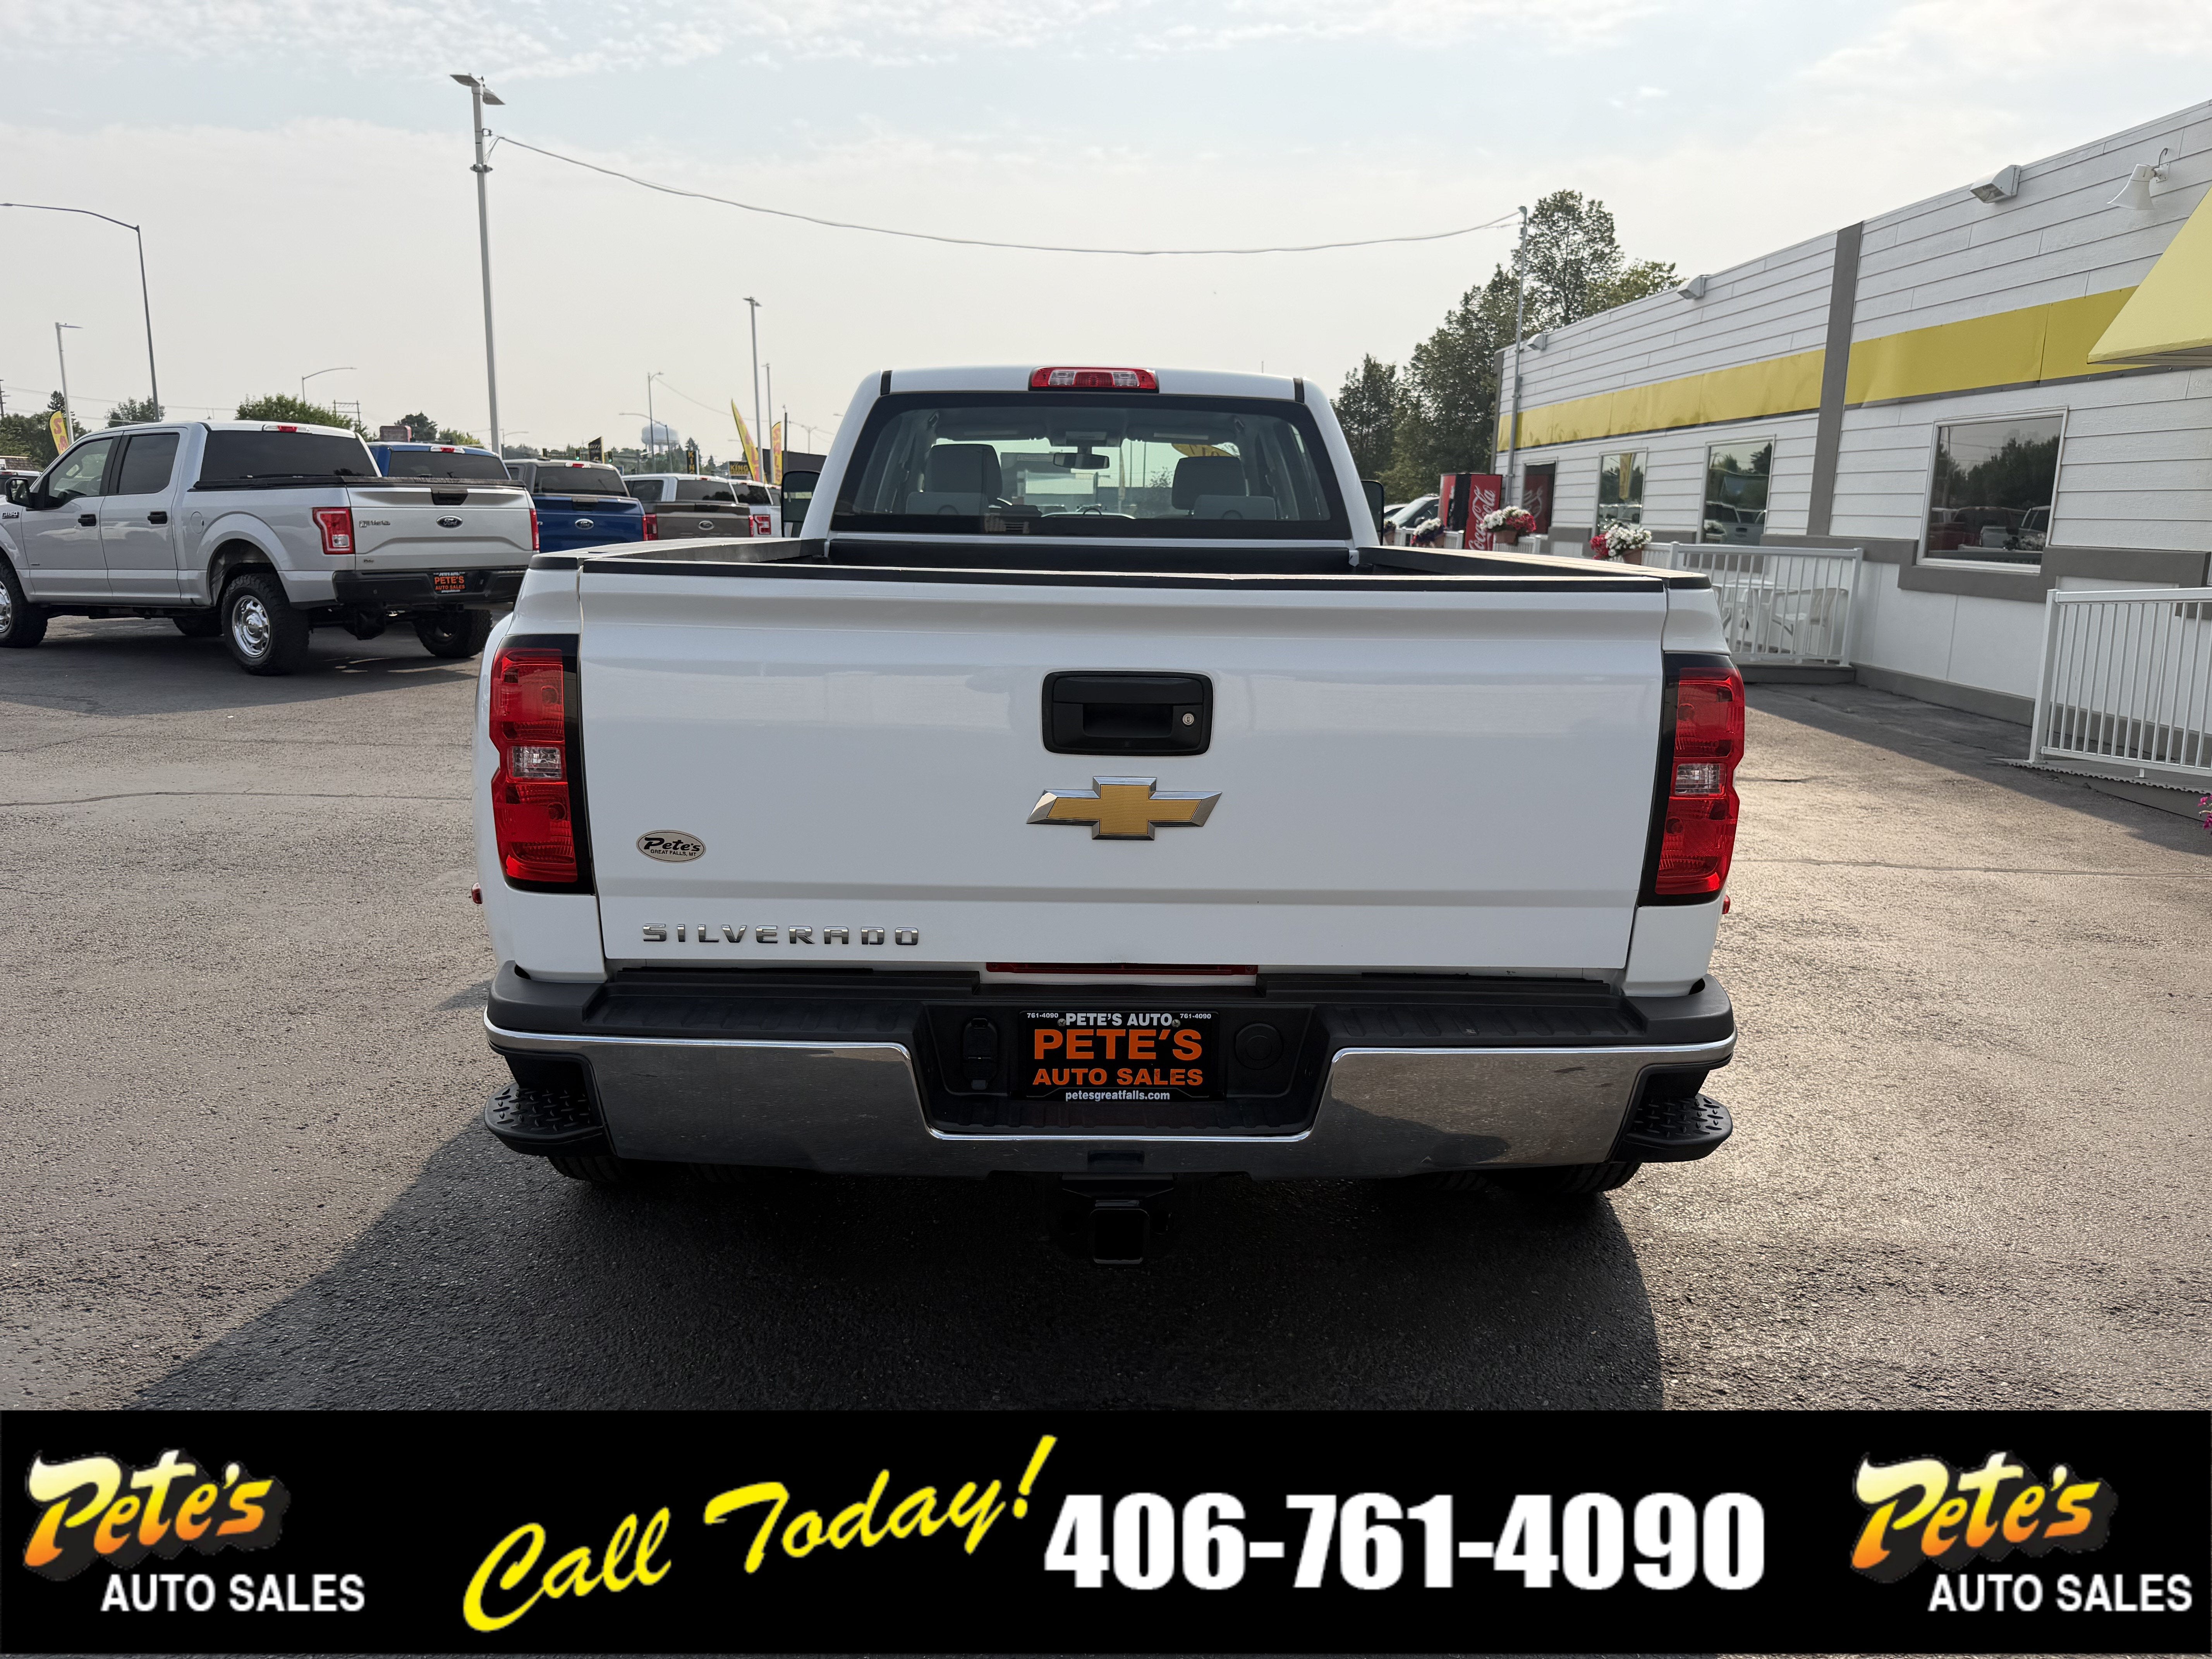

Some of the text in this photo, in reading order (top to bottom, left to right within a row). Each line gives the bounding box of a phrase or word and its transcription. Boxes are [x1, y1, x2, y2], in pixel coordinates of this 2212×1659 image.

[444, 518, 458, 526] Ford
[434, 576, 464, 584] PETE'S
[644, 837, 701, 852] Pete's
[643, 923, 919, 946] SILVERADO
[1066, 1013, 1173, 1026] PETE'S AUTO
[1034, 1029, 1202, 1060] PETE'S
[1032, 1068, 1203, 1085] AUTO SALES
[1066, 1090, 1170, 1102] petesgreatfalls.com
